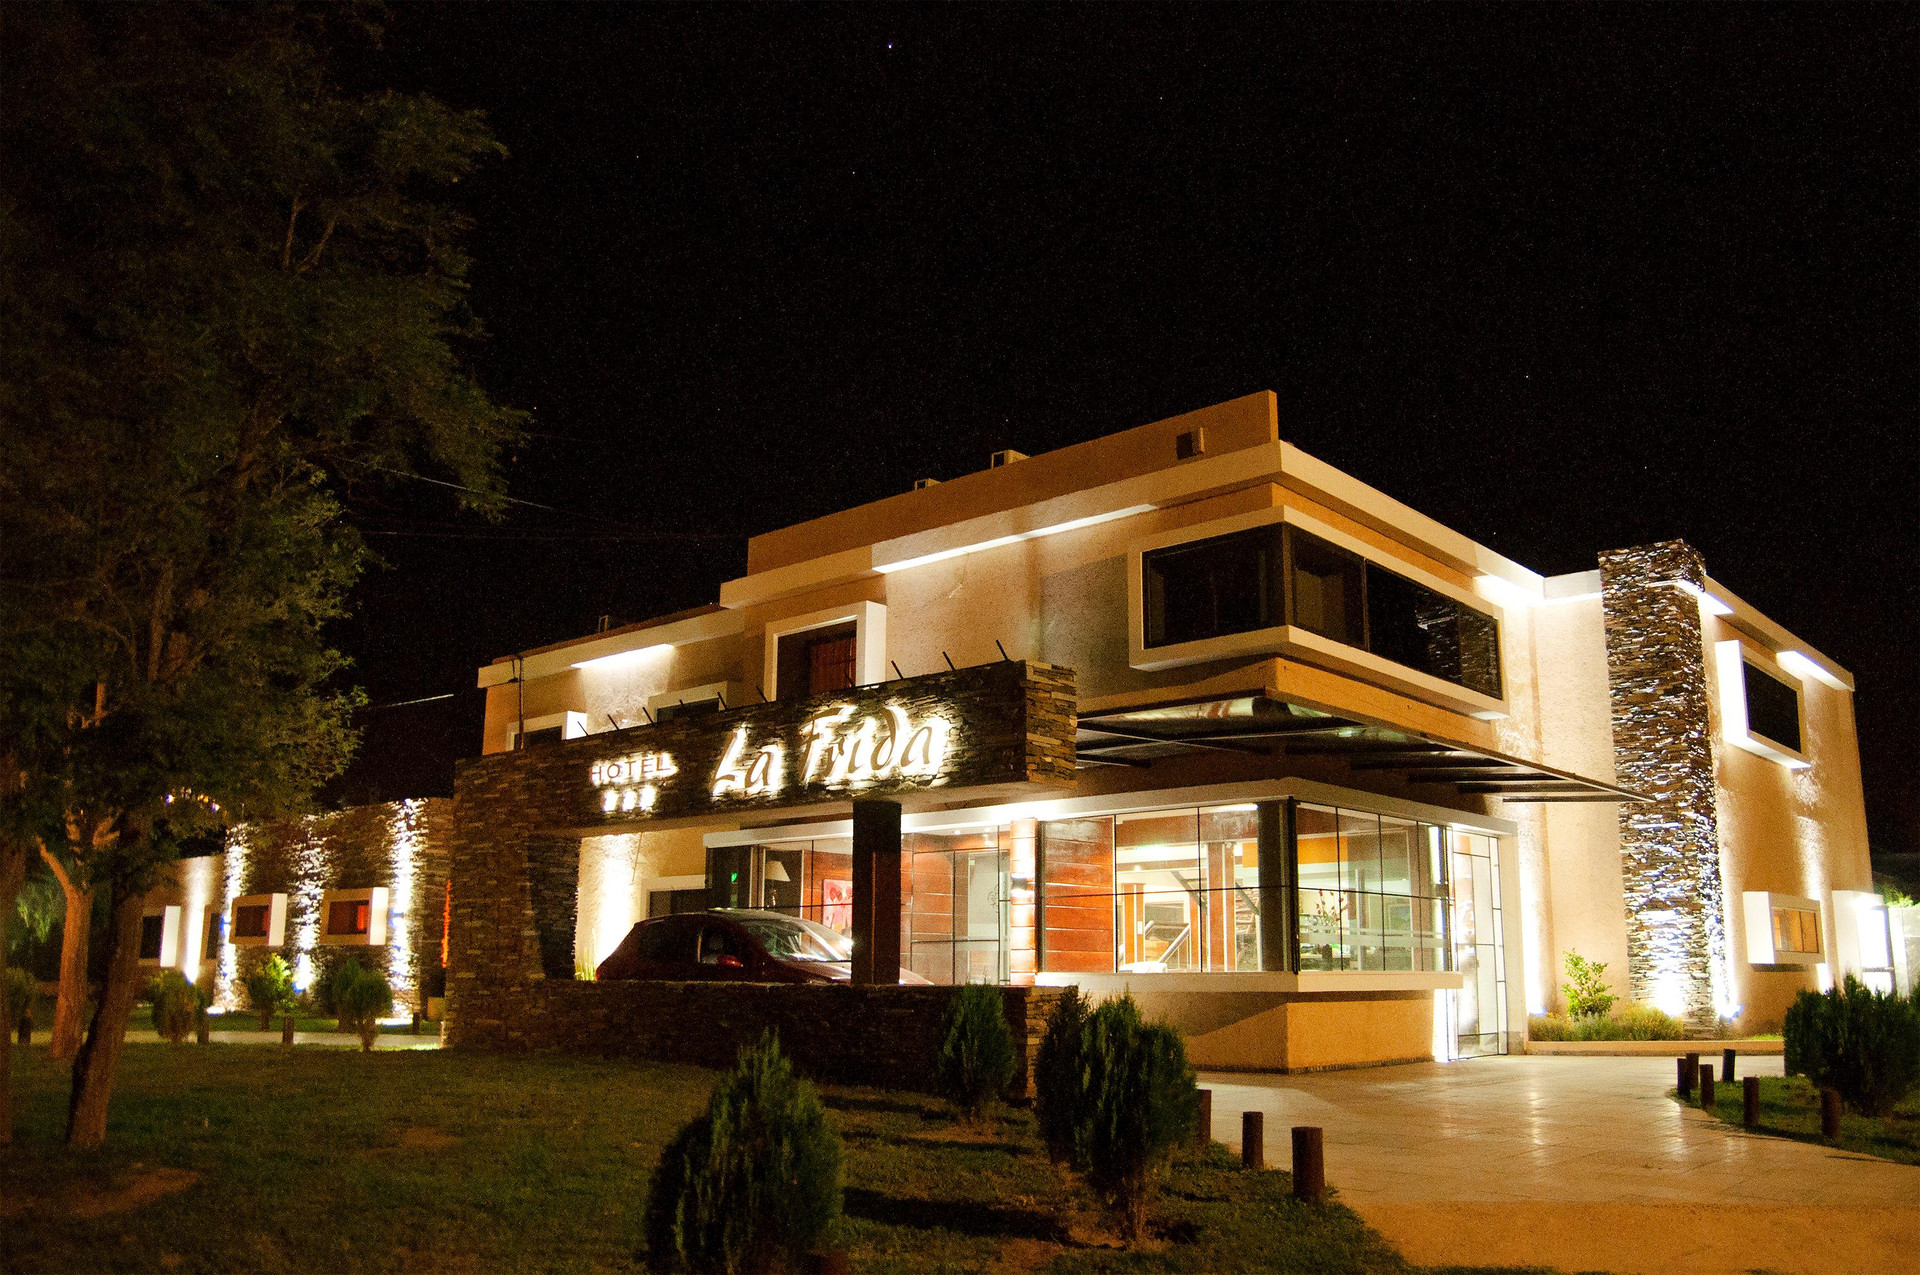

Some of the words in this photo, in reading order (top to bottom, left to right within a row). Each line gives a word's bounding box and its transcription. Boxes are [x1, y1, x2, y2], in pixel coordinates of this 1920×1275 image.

[589, 756, 672, 782] HOTEL
[709, 730, 775, 795] La
[798, 705, 936, 782] Frida
